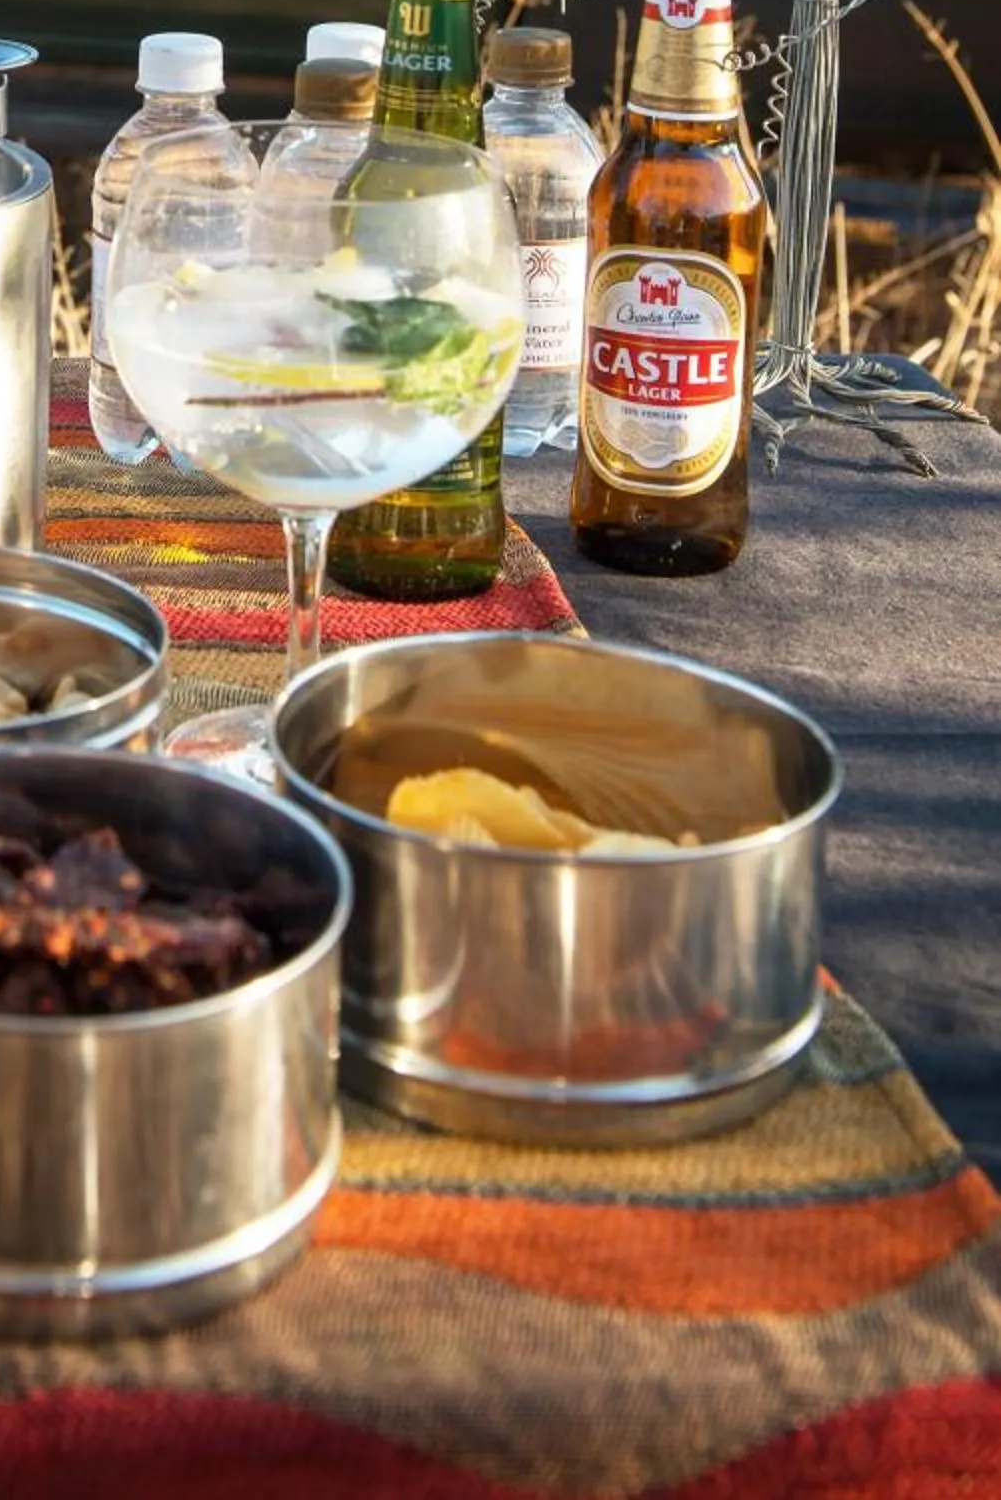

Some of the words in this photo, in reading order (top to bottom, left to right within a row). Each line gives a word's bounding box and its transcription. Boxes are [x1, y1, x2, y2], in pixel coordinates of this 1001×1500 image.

[383, 49, 453, 72] LAGER
[526, 320, 570, 334] ineral
[592, 341, 729, 385] CASTLE
[628, 383, 682, 402] LAGER
